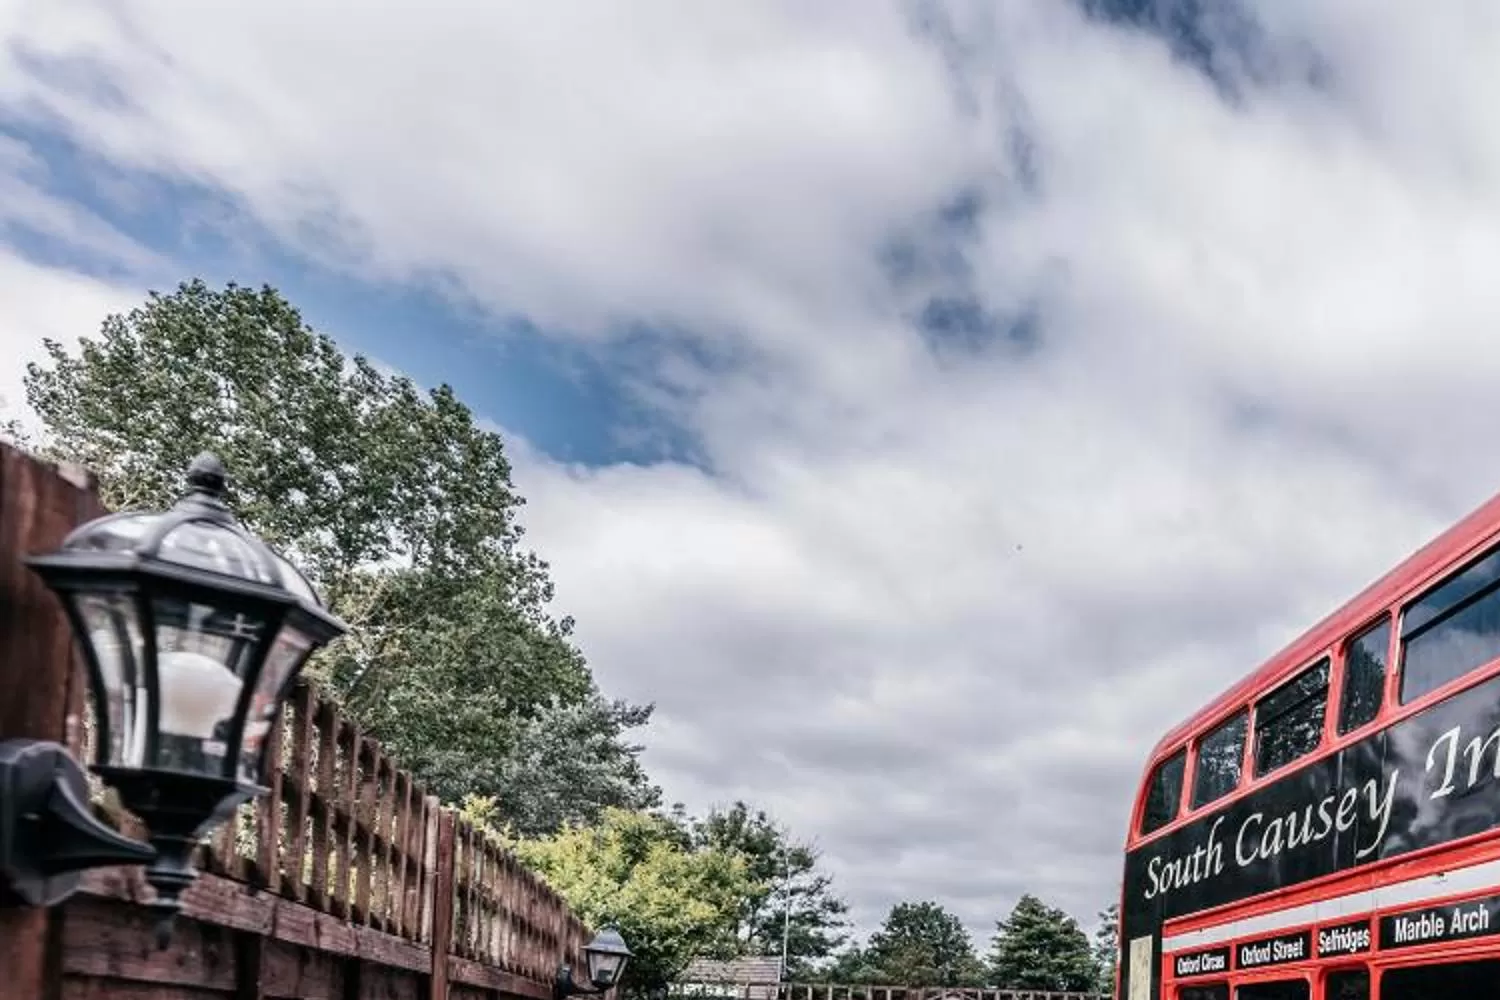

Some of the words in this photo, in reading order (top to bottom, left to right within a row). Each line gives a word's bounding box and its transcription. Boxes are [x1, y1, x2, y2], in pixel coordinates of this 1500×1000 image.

[1144, 815, 1224, 899] South
[1235, 768, 1399, 866] Causey
[1394, 910, 1444, 943] Marble
[1449, 903, 1489, 934] Arch
[1241, 942, 1271, 965] Oxford
[1273, 937, 1304, 961] Street
[1318, 926, 1371, 953] Selfridges
[1177, 955, 1200, 975] Oxford
[1201, 953, 1225, 971] Circus
